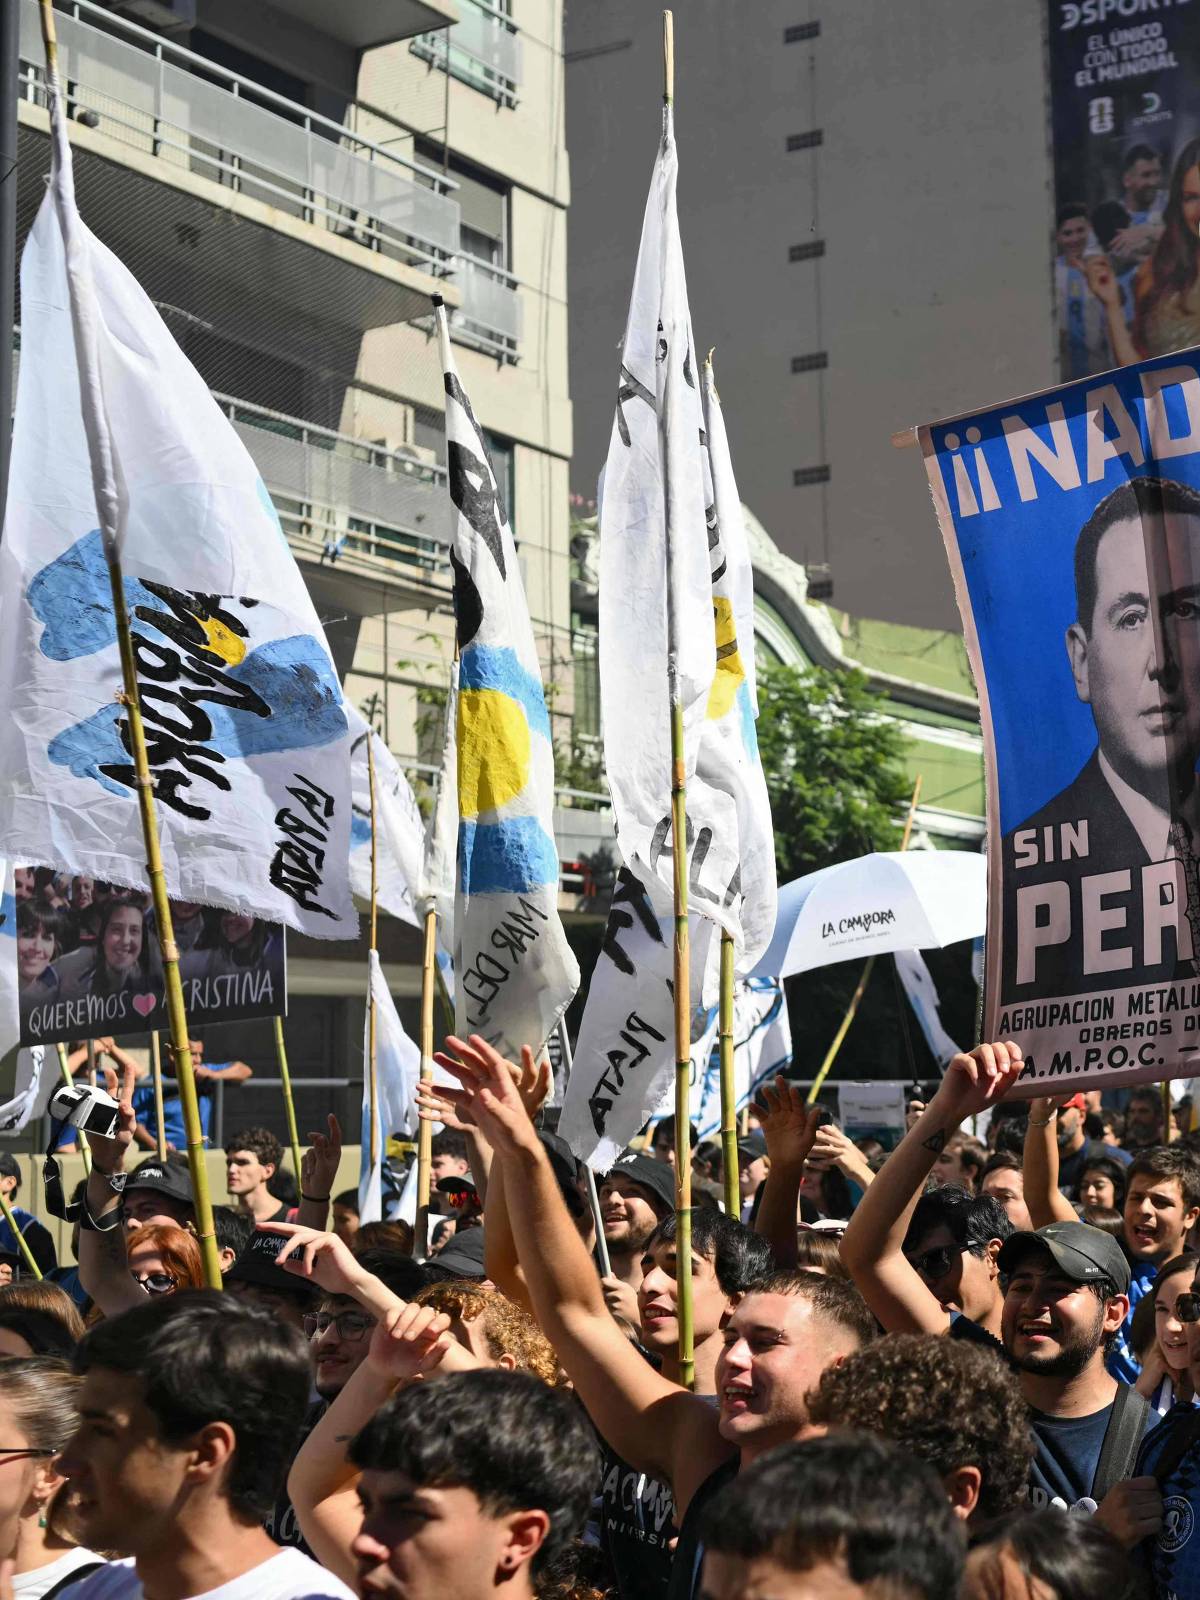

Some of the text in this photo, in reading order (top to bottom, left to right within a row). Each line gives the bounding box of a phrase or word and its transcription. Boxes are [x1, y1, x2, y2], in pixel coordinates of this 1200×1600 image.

[1083, 37, 1168, 68] CON TODO
[1087, 34, 1107, 50] EL
[1075, 52, 1178, 87] EL MUNDIAL
[1014, 819, 1089, 869] SIN
[822, 921, 836, 939] LA
[28, 990, 127, 1036] QUEREMOS
[999, 996, 1115, 1036] AGRUPACION
[1080, 1018, 1172, 1044] OBREROS
[1018, 1042, 1165, 1080] A.M.P.O.C.
